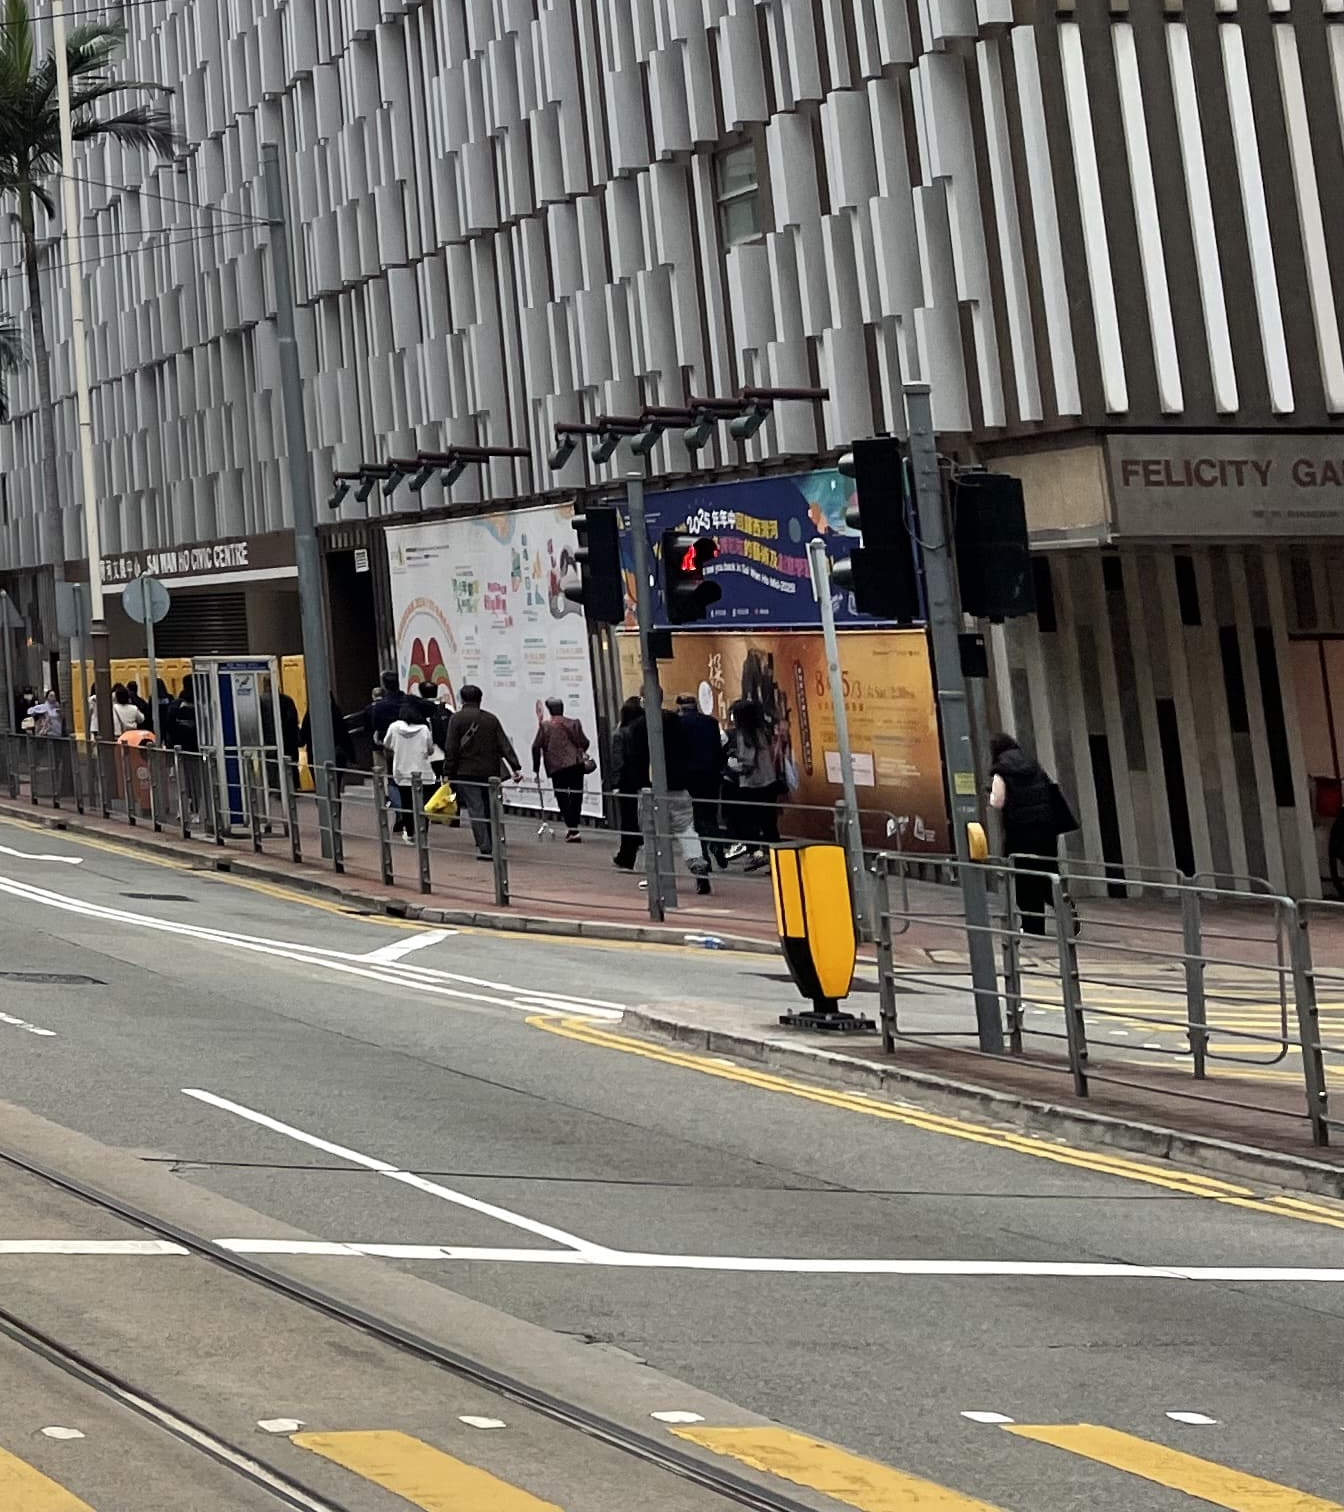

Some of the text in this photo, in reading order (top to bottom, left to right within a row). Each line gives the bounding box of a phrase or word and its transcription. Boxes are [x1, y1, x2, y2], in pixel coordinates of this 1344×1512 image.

[1121, 458, 1344, 487] FELICITY GA
[178, 550, 189, 572] HO
[191, 548, 212, 571] CIVIC
[213, 542, 249, 568] CENTRE
